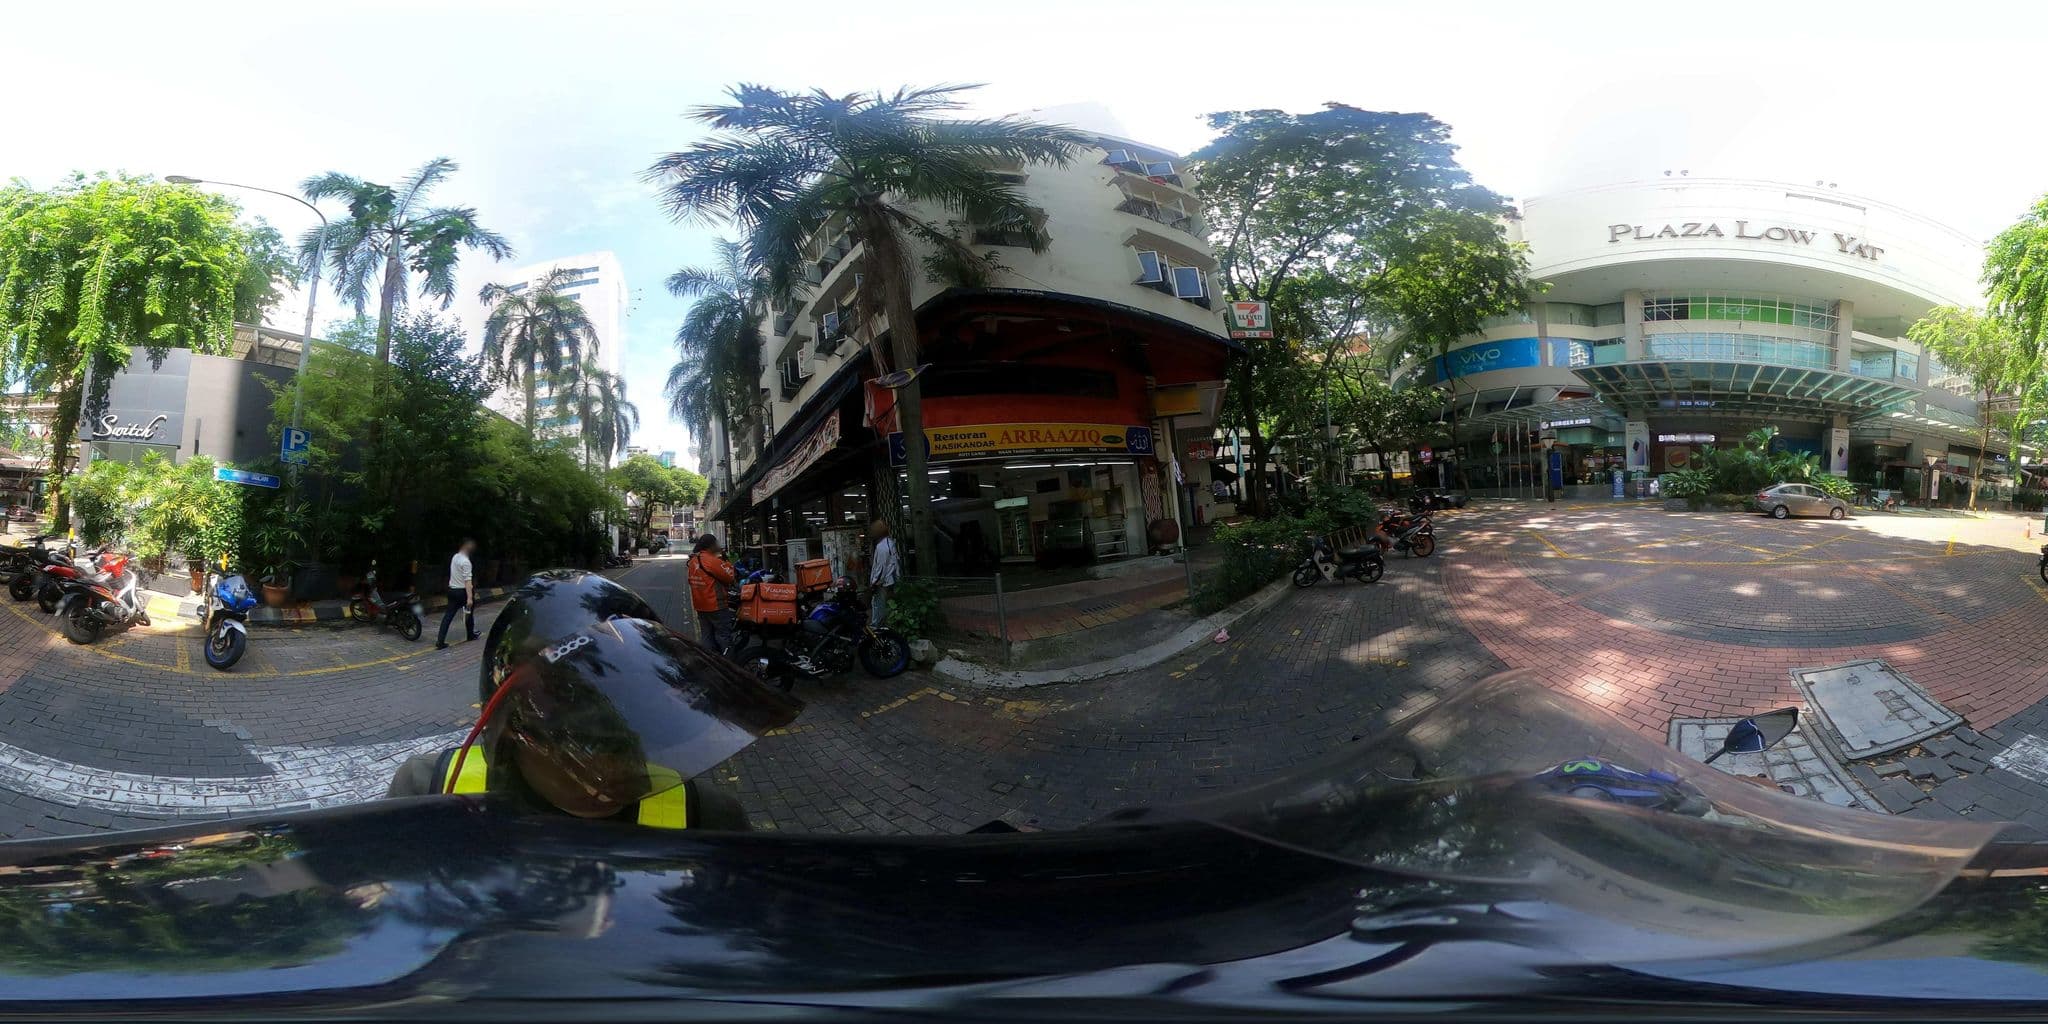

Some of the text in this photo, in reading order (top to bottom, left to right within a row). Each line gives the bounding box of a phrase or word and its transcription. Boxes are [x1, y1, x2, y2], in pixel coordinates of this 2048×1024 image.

[1608, 220, 1885, 261] PLAZA LOW YAT
[1717, 306, 1754, 315] acer
[92, 415, 168, 440] Switch
[933, 431, 987, 442] Restoran
[290, 429, 306, 449] P
[1000, 429, 1101, 446] ARRAAZIQ
